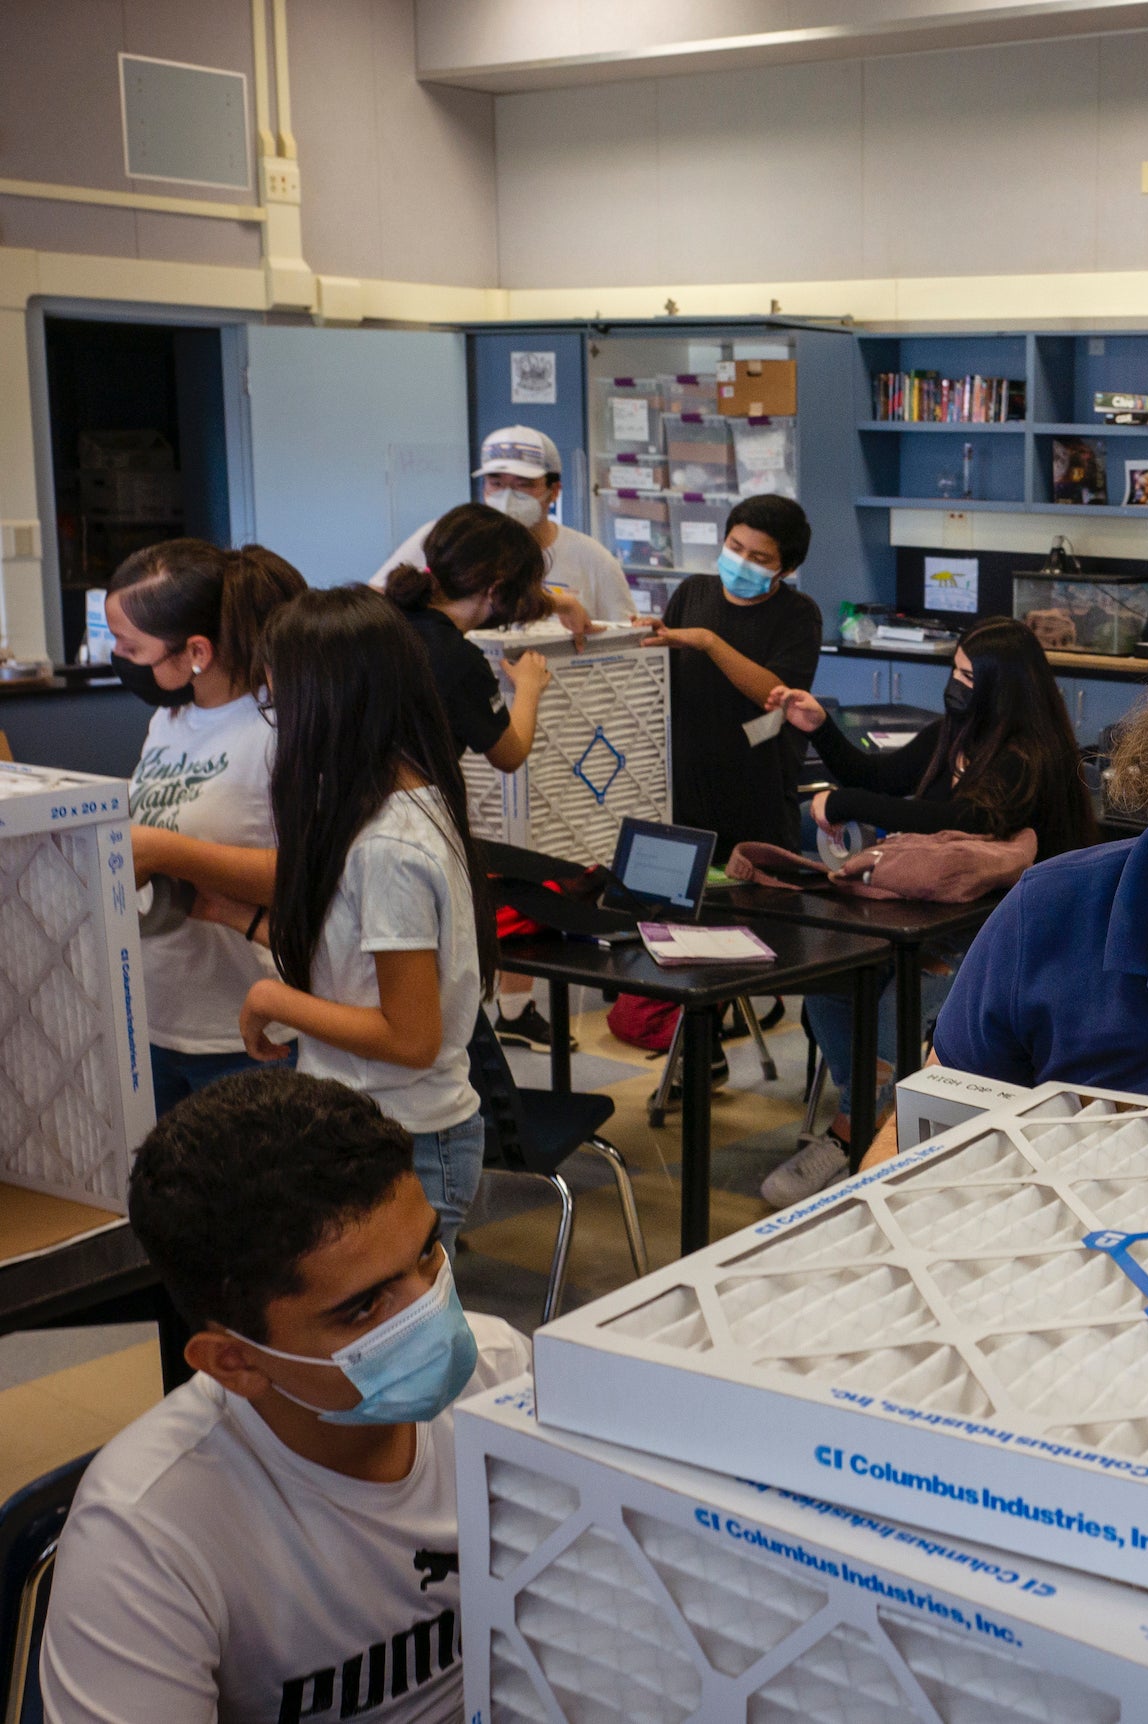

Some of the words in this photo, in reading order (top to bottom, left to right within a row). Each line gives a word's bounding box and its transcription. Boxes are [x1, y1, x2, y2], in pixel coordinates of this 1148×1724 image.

[51, 805, 67, 819] 20
[71, 808, 78, 816] x
[81, 801, 97, 815] 20
[111, 798, 119, 810] 2
[778, 1186, 852, 1226] Columbus
[849, 1153, 922, 1195] Industries,
[917, 1144, 945, 1161] Inc.
[830, 1387, 875, 1408] Inc.
[881, 1399, 1014, 1444] Industries,
[779, 1486, 894, 1538] Industries
[814, 1444, 844, 1470] CI
[849, 1454, 978, 1506] Columbus
[982, 1488, 1126, 1549] Industries,
[694, 1508, 720, 1532] CI
[725, 1518, 839, 1578] Columbus
[841, 1563, 973, 1631] Industries,
[975, 1612, 1023, 1647] Inc.
[896, 1531, 1019, 1585] Columbus
[278, 1608, 462, 1724] PUM
